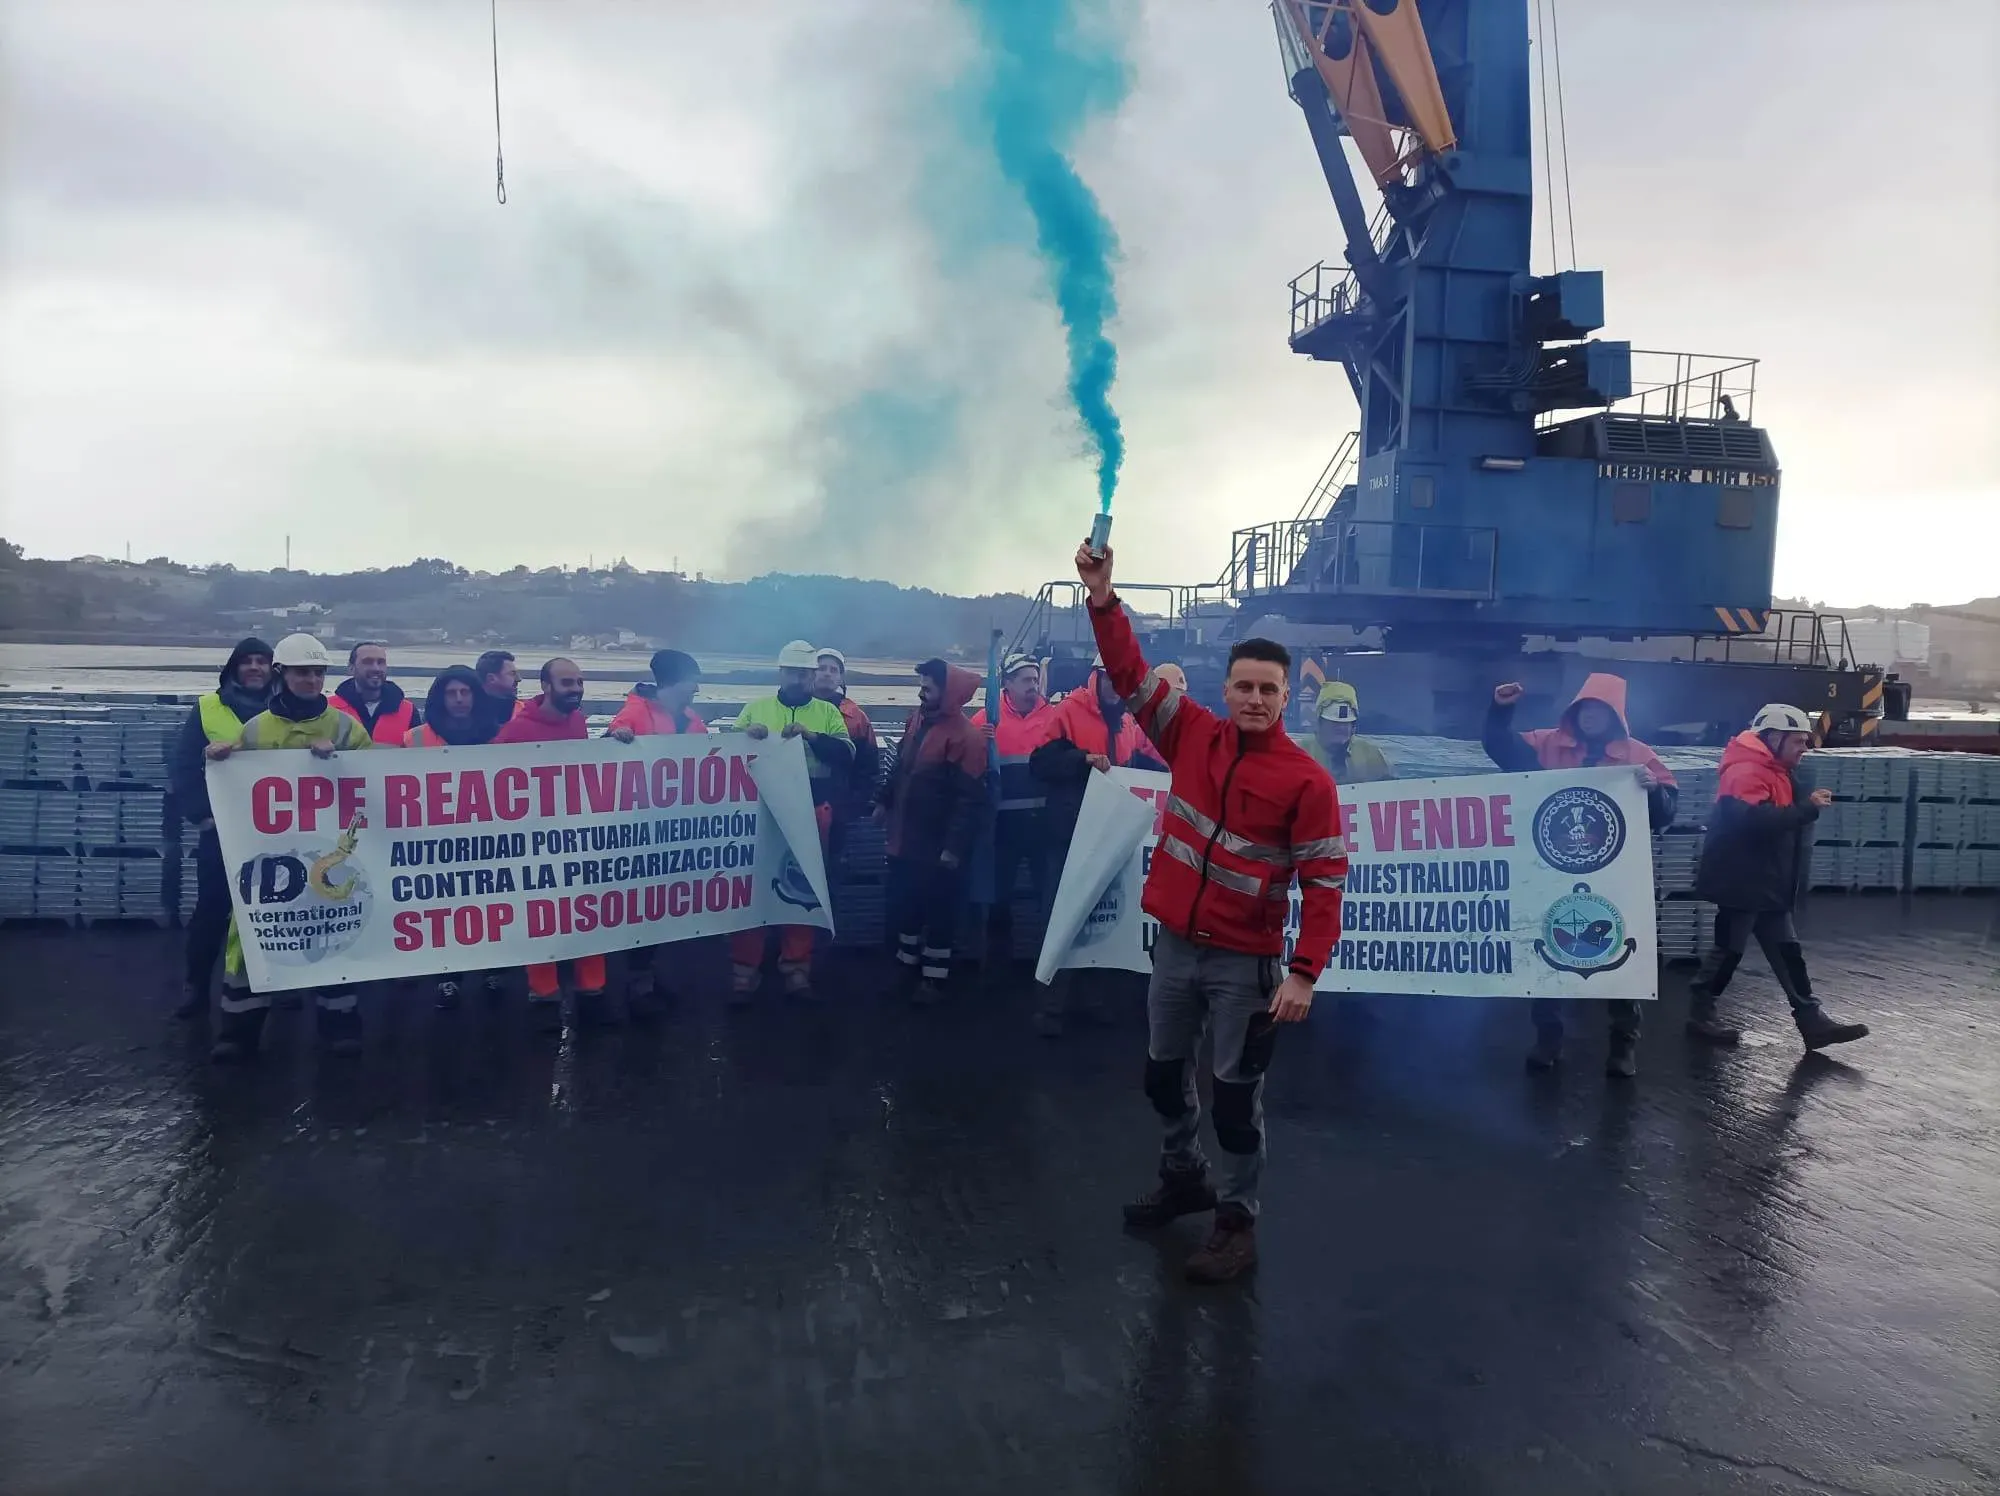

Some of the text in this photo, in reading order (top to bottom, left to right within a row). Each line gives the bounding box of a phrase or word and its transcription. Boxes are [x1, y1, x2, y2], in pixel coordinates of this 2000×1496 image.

[1600, 463, 1692, 484] LIEBHERR
[1828, 682, 1837, 698] 3
[252, 747, 759, 834] CPE REACTIVACIÓN
[1555, 790, 1599, 802] SEPRA
[390, 809, 757, 867] AUTORIDAD PORTUARIA MEDIACIÓN
[1368, 794, 1515, 852] VENDE
[392, 840, 755, 902] CONTRA LA PRECARIZACIÓN
[1346, 859, 1511, 894] NIESTRALIDAD
[392, 870, 753, 952] STOP DISOLUCIÓN
[1342, 893, 1511, 933] BERALIZACIÓN
